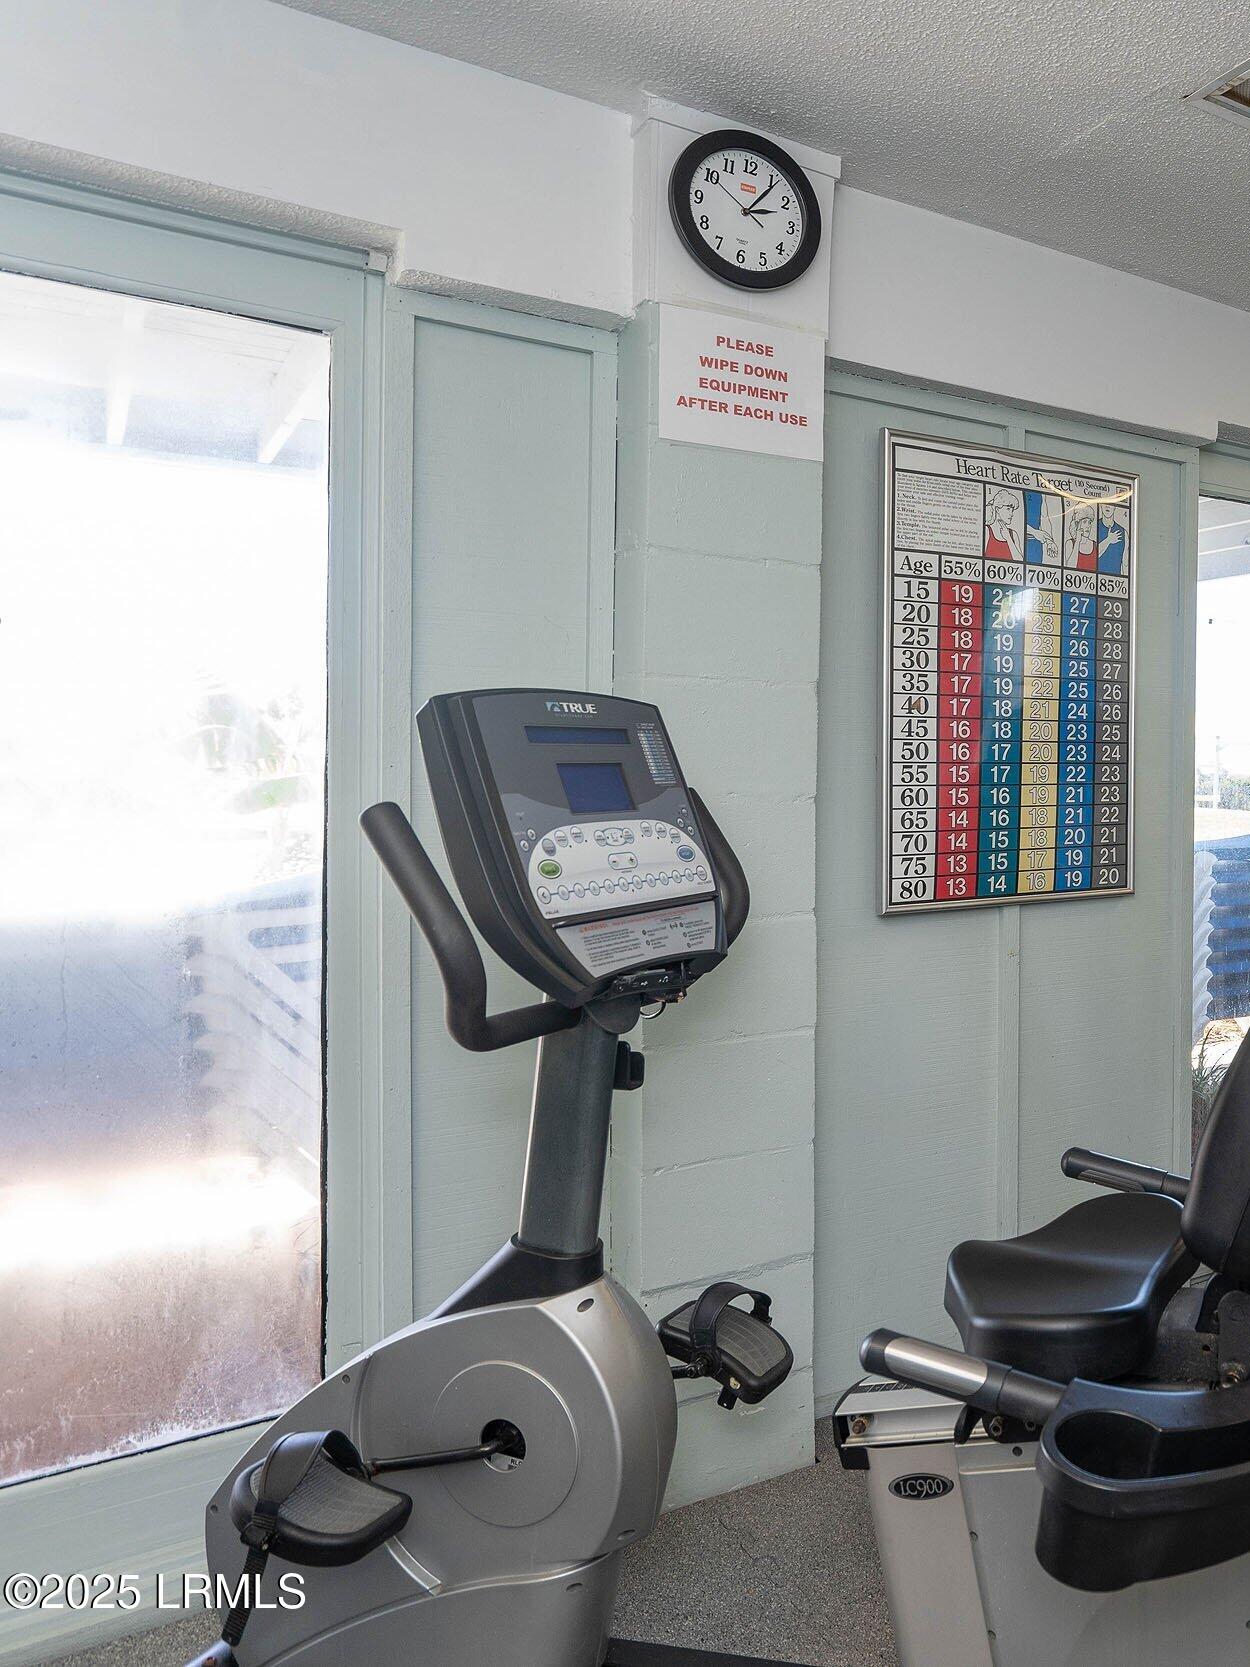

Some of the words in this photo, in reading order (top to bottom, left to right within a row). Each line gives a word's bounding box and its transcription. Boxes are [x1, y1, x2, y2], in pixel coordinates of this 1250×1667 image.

[704, 168, 720, 185] 10
[723, 158, 735, 175] 11
[743, 159, 758, 176] 12
[769, 174, 774, 187] 1
[694, 190, 704, 204] 9
[781, 196, 790, 210] 2
[700, 215, 709, 230] 8
[786, 221, 795, 235] 3
[715, 235, 723, 250] 7
[776, 242, 785, 255] 4
[736, 250, 745, 263] 6
[759, 252, 767, 266] 5
[716, 336, 774, 357] PLEASE
[699, 355, 739, 373] WIPE
[744, 364, 788, 382] DOWN
[699, 377, 789, 403] EQUIPMENT
[676, 395, 729, 414] AFTER
[733, 404, 774, 421] EACH
[779, 412, 808, 427] USE
[955, 458, 997, 480] Heart
[1000, 466, 1030, 486] Rate
[1032, 472, 1073, 492] Target
[988, 487, 992, 495] 1
[900, 555, 933, 574] Age
[943, 560, 981, 578] 55%
[987, 564, 1023, 582] 60%
[1027, 569, 1060, 587] 70%
[1064, 574, 1095, 591] 80%
[1099, 578, 1128, 595] 85%
[903, 581, 931, 599] 15
[951, 584, 973, 603] 19
[991, 589, 1014, 605] 21
[1032, 592, 1054, 610] 24
[1069, 597, 1089, 613] 27
[1102, 601, 1122, 618] 29
[903, 604, 931, 622] 20
[951, 607, 972, 625] 18
[991, 611, 1013, 627] 20
[1032, 614, 1054, 632] 23
[1068, 618, 1089, 634] 27
[1102, 622, 1122, 638] 28
[902, 627, 930, 645] 25
[950, 630, 972, 648] 18
[991, 633, 1012, 649] 19
[1031, 635, 1053, 653] 23
[1068, 639, 1088, 655] 26
[1102, 642, 1121, 659] 28
[902, 650, 930, 668] 30
[950, 652, 971, 670] 17
[990, 655, 1012, 671] 19
[1031, 657, 1052, 675] 22
[1068, 660, 1088, 676] 25
[1101, 663, 1121, 679] 27
[902, 673, 930, 691] 35
[949, 675, 971, 693] 17
[990, 677, 1011, 693] 19
[1030, 679, 1052, 696] 22
[1067, 681, 1087, 697] 25
[1101, 683, 1121, 700] 26
[560, 702, 597, 714] TRUE
[902, 696, 929, 714] 40
[949, 697, 970, 715] 17
[990, 700, 1011, 716] 18
[1030, 700, 1051, 718] 21
[1067, 702, 1087, 718] 24
[1101, 704, 1121, 720] 26
[901, 719, 929, 737] 45
[949, 720, 970, 738] 16
[989, 722, 1010, 738] 18
[1029, 722, 1050, 739] 20
[1066, 723, 1086, 739] 23
[1101, 725, 1120, 741] 25
[901, 742, 929, 760] 50
[948, 743, 969, 760] 16
[989, 744, 1010, 760] 17
[1029, 743, 1050, 761] 20
[1066, 744, 1086, 760] 23
[1100, 745, 1120, 761] 24
[901, 765, 929, 783] 55
[948, 765, 969, 783] 15
[989, 766, 1009, 782] 17
[1028, 765, 1049, 782] 19
[1066, 765, 1085, 781] 22
[1100, 766, 1120, 782] 23
[900, 788, 928, 806] 60
[948, 788, 968, 805] 15
[988, 788, 1009, 804] 16
[1028, 787, 1048, 803] 19
[1065, 786, 1085, 802] 21
[1100, 786, 1119, 802] 23
[900, 811, 928, 830] 65
[947, 810, 968, 828] 14
[988, 810, 1008, 826] 16
[1027, 808, 1048, 825] 18
[1065, 807, 1084, 823] 21
[1100, 807, 1119, 823] 22
[900, 834, 928, 853] 70
[947, 833, 967, 850] 14
[987, 832, 1007, 848] 15
[1027, 830, 1047, 846] 18
[1064, 828, 1084, 844] 20
[1099, 828, 1119, 843] 21
[899, 857, 928, 876] 75
[946, 855, 967, 873] 13
[987, 854, 1007, 870] 15
[1026, 851, 1046, 868] 17
[1064, 849, 1083, 865] 19
[1099, 848, 1119, 864] 21
[899, 880, 927, 899] 80
[946, 878, 966, 895] 13
[987, 876, 1006, 892] 14
[1026, 873, 1046, 889] 16
[1064, 870, 1083, 886] 19
[1099, 869, 1118, 884] 20
[900, 1478, 943, 1498] LC900
